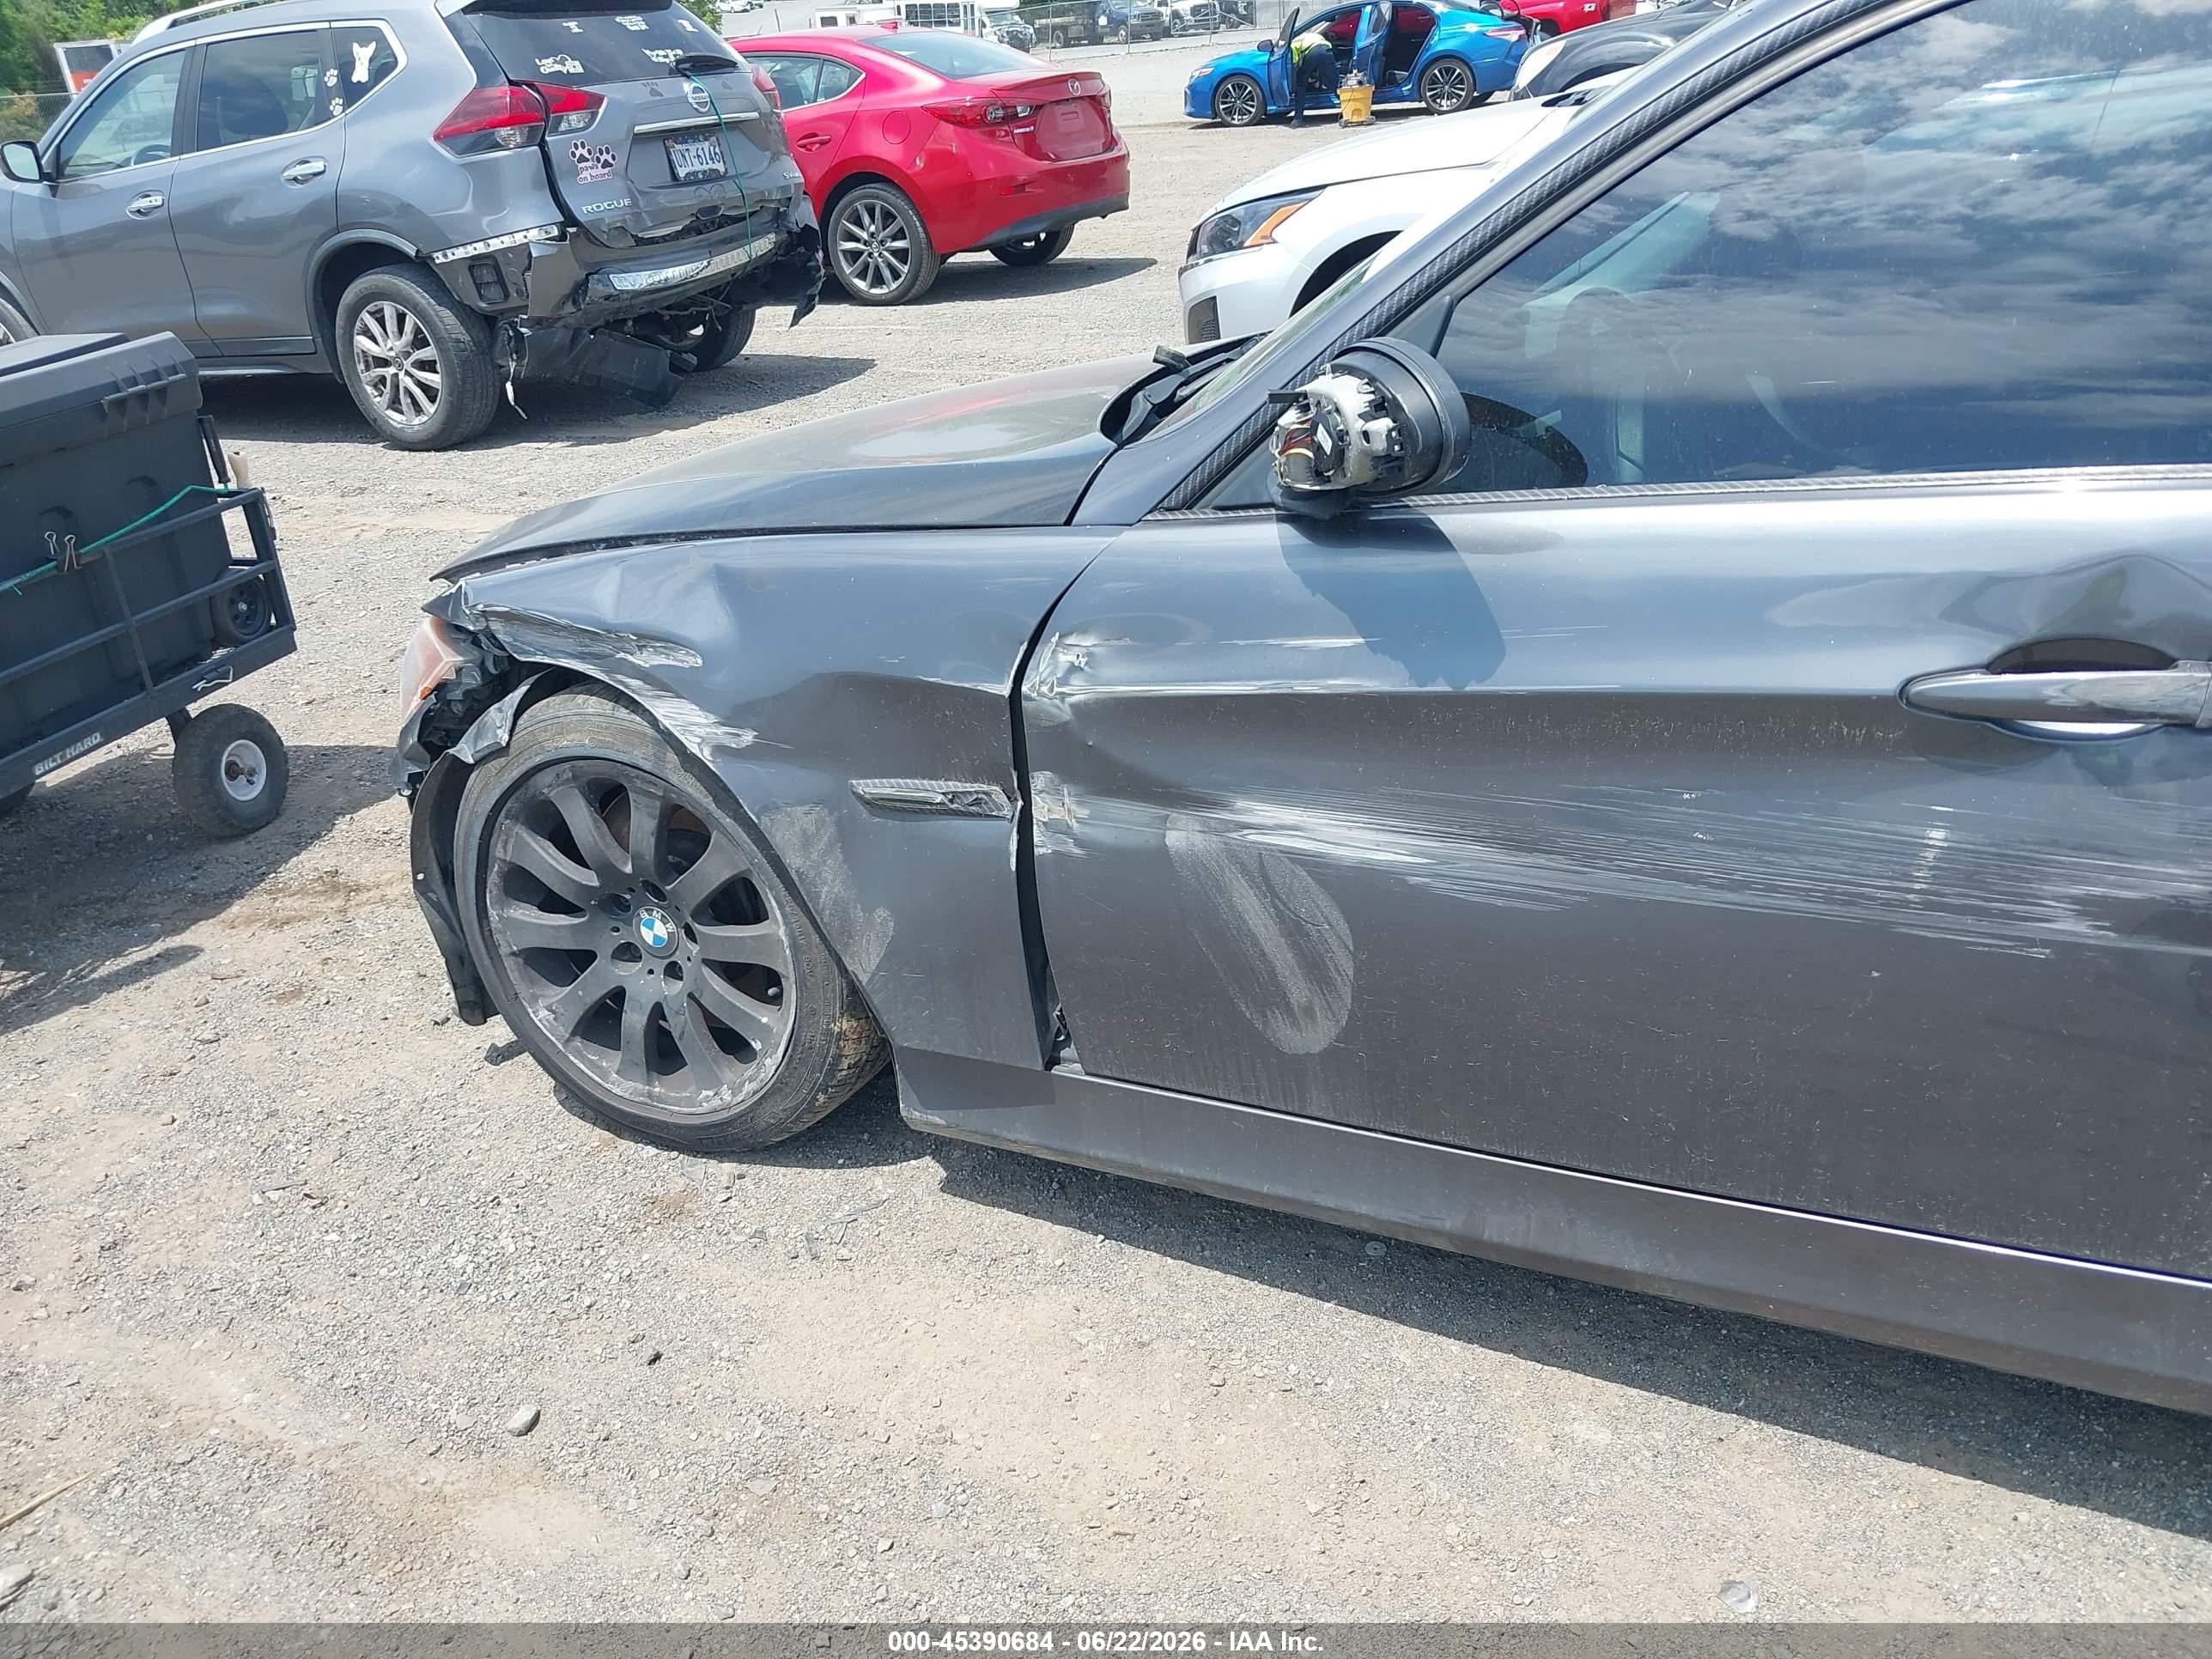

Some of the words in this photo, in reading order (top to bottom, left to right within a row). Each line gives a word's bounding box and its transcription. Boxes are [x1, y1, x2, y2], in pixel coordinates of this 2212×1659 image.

[579, 163, 599, 174] paws
[589, 170, 612, 181] board
[581, 198, 633, 214] ROGUE
[34, 751, 63, 775] BILT
